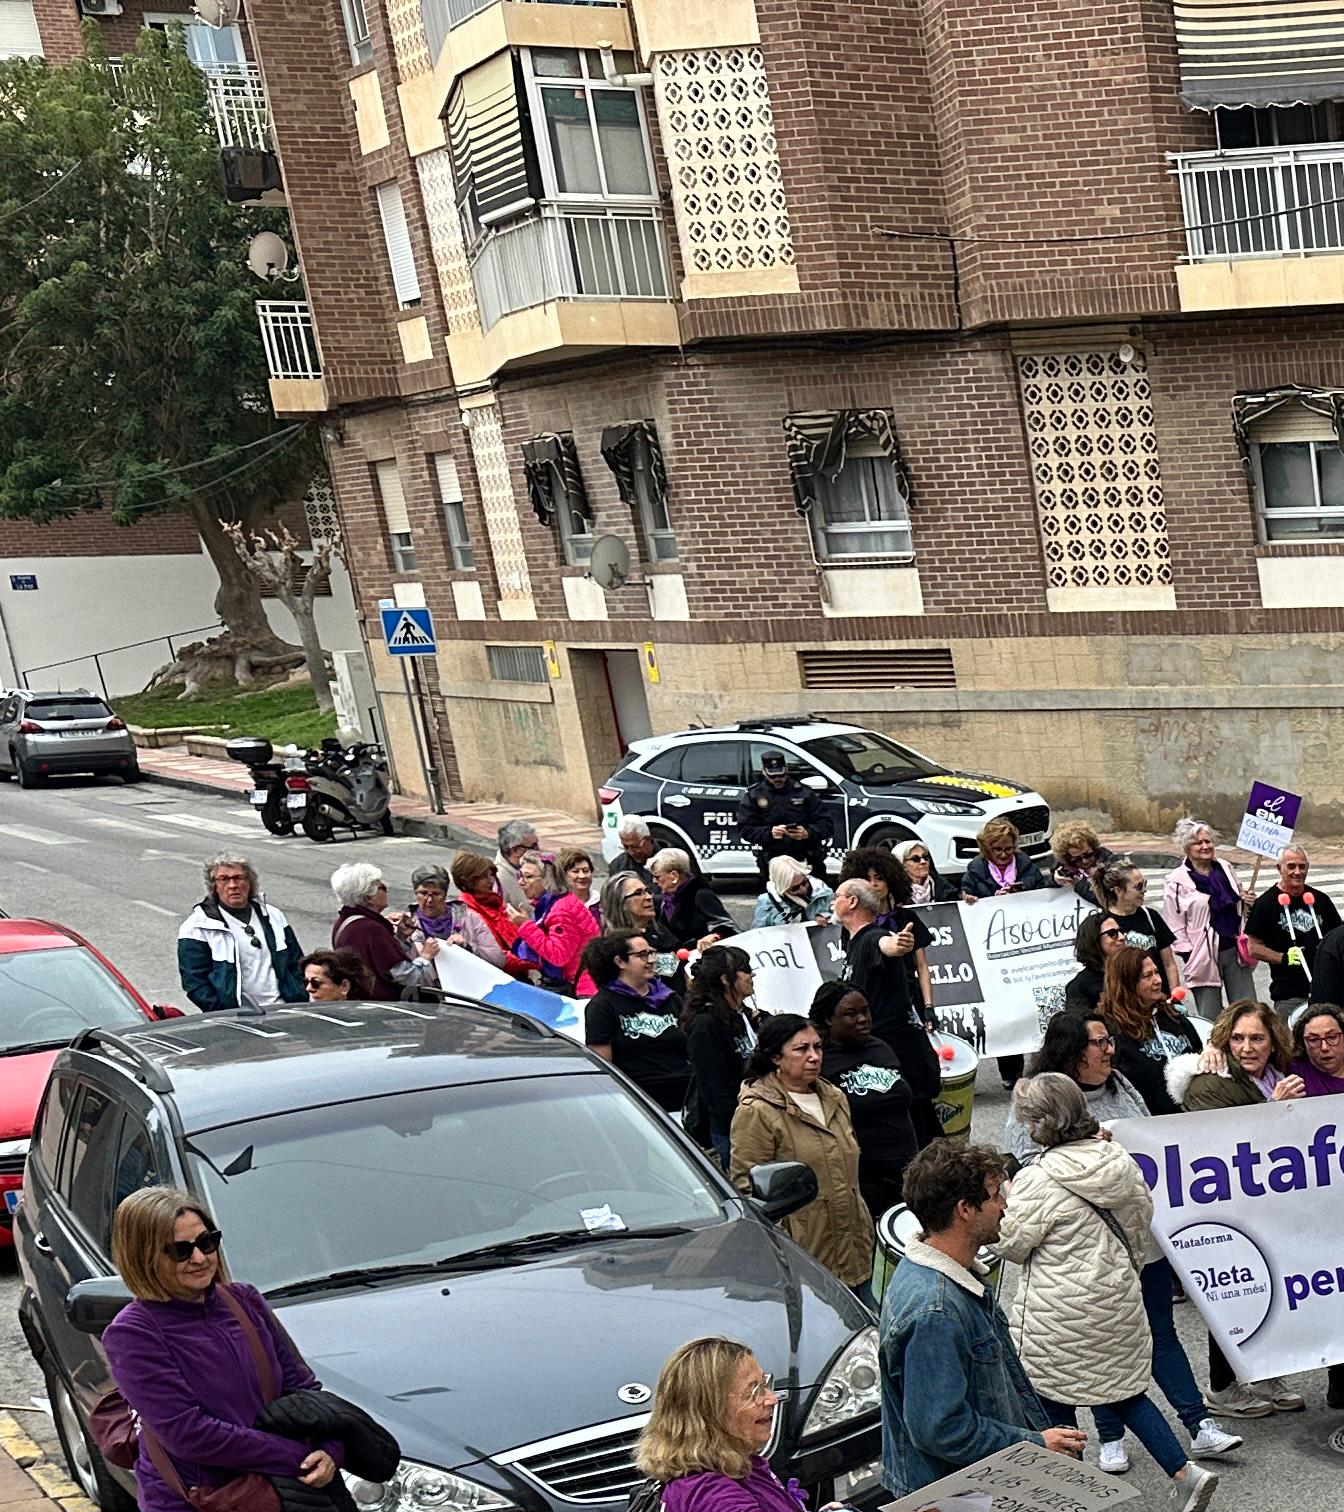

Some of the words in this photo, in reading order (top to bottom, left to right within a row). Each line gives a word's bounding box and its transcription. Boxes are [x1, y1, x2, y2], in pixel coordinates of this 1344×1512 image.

[1263, 795, 1286, 812] el
[1255, 808, 1284, 826] 8M
[1171, 1232, 1234, 1251] Plataforma
[1221, 1287, 1242, 1301] una
[1002, 1446, 1047, 1467] NOS
